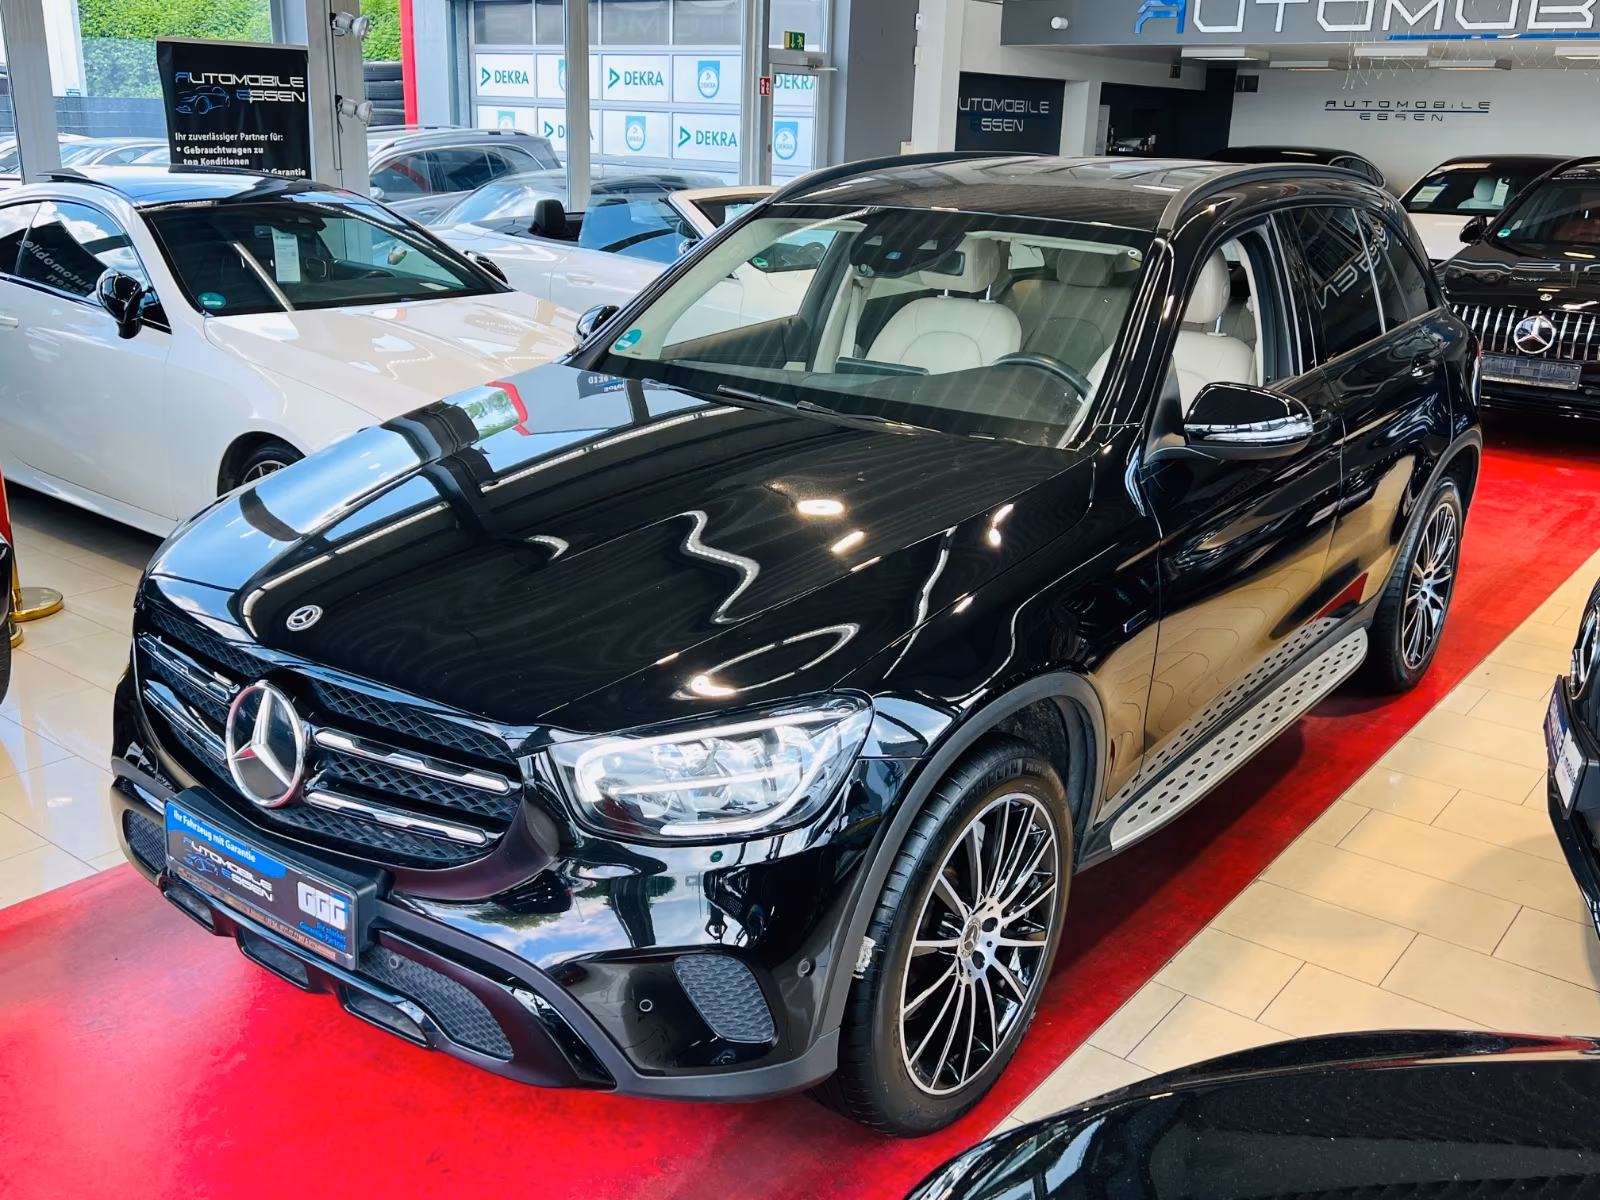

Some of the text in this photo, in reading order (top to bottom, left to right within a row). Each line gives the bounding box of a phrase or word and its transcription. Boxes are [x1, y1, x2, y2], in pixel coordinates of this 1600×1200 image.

[1134, 0, 1597, 34] AUTOMOB
[175, 72, 305, 88] AUTOMOBILE
[494, 70, 530, 85] DEKRA
[624, 70, 664, 87] DEKRA
[236, 89, 306, 103] ESSEN
[958, 97, 1050, 114] UTOMOBILE
[1324, 100, 1491, 110] AUTOMOBILE
[1359, 112, 1444, 122] ESSEN
[175, 132, 284, 143] Ihr zuverlässiger Partner für:
[696, 130, 738, 147] DEKRA
[183, 145, 264, 156] Gebrauchtwagen zu
[200, 157, 250, 166] Konditionen
[271, 168, 306, 176] Garantie
[173, 809, 256, 863] Ihr Fahrzeug mit Garantie
[183, 836, 273, 892] AUTOMOBILE
[221, 867, 273, 902] ESSEN
